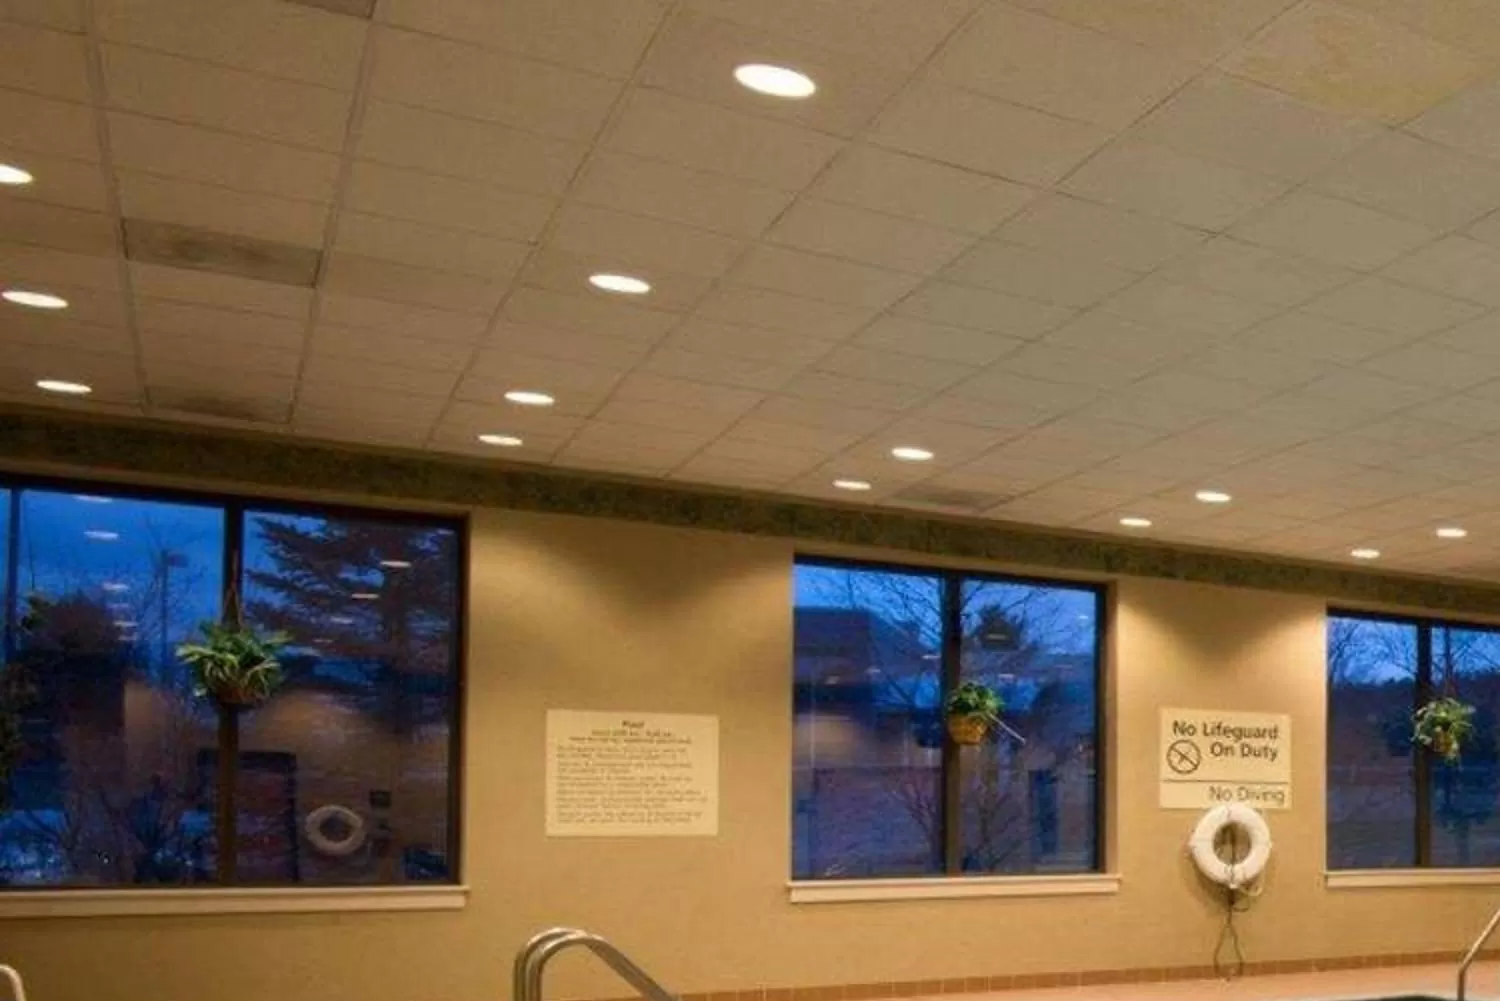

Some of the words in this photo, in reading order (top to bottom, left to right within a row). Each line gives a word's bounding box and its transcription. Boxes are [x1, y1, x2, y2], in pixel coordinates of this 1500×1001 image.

[1172, 720, 1197, 737] No
[1202, 721, 1279, 743] Lifeguard
[1210, 741, 1235, 757] On
[1241, 743, 1278, 762] Duty
[1210, 786, 1233, 801] No
[1237, 786, 1285, 805] Diving
